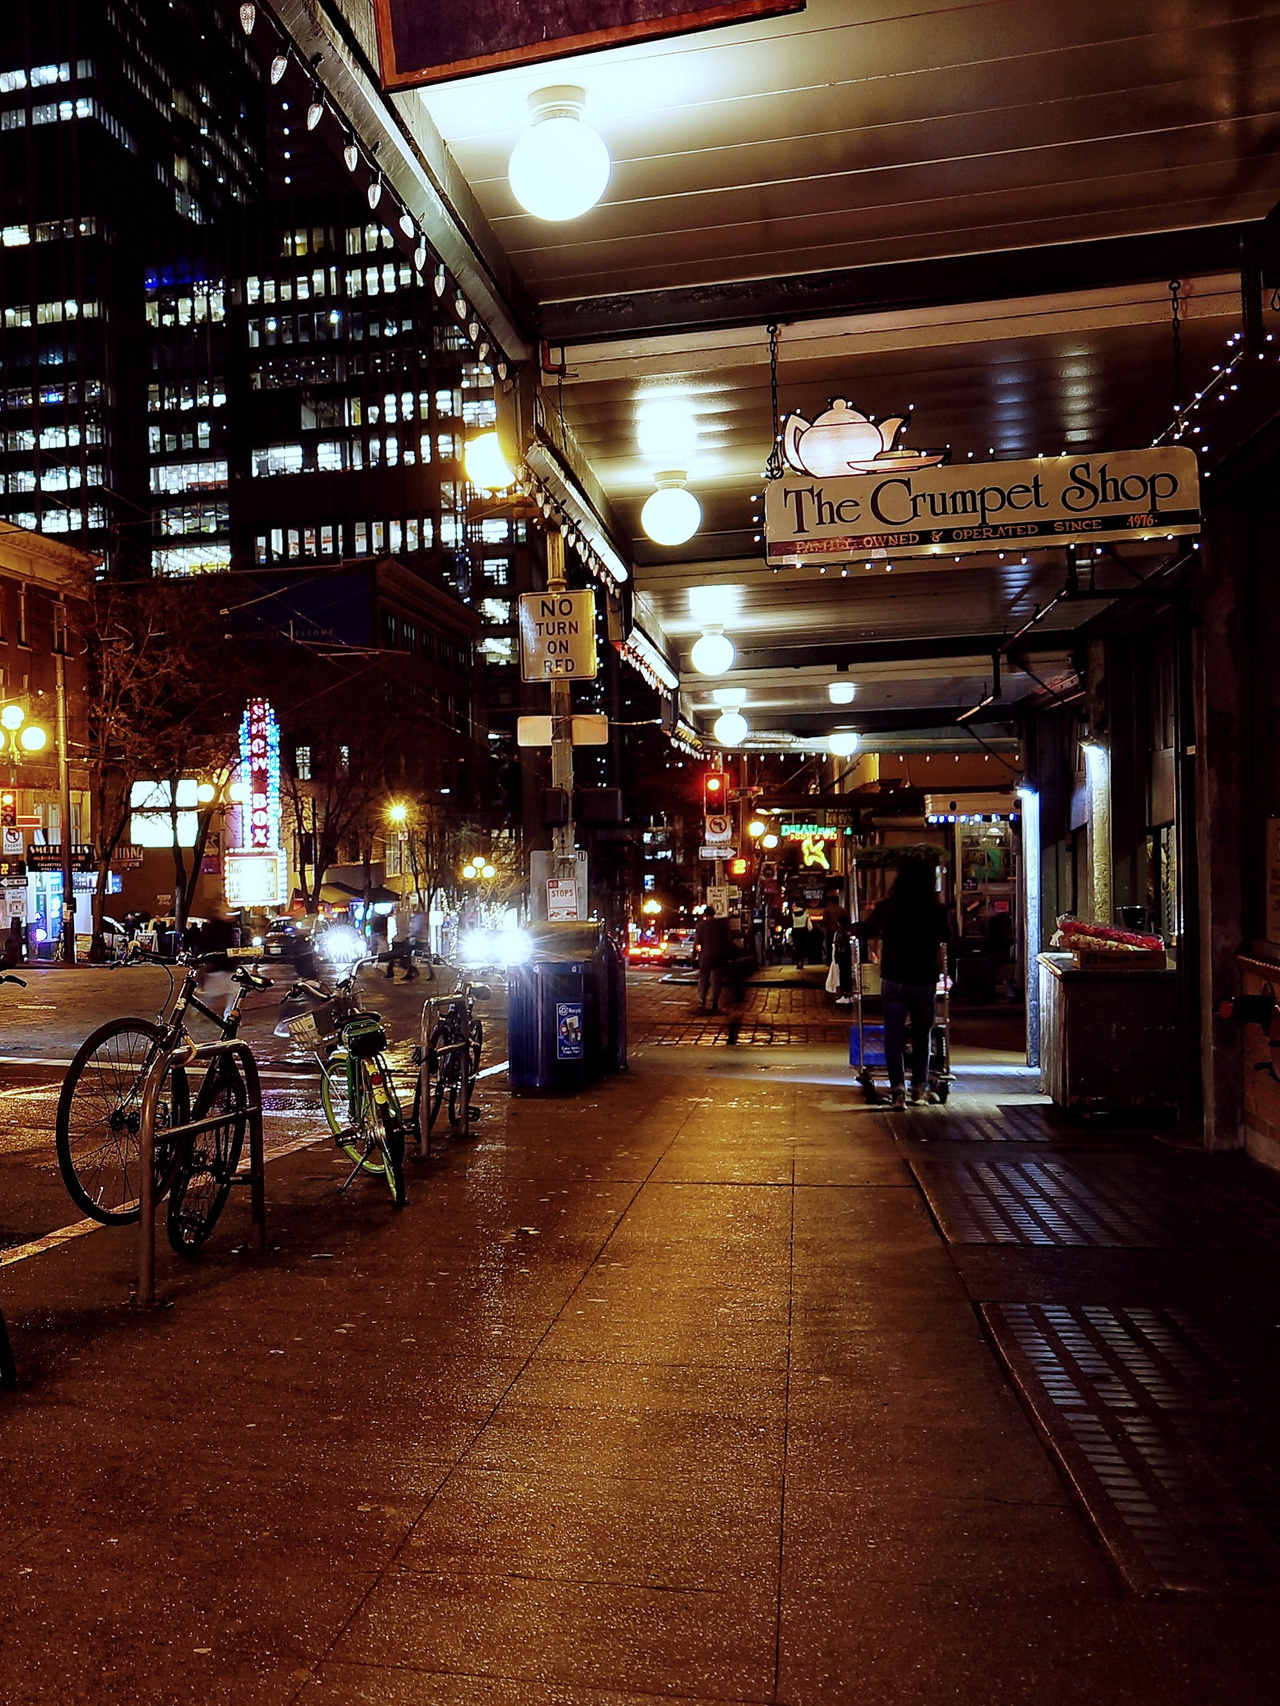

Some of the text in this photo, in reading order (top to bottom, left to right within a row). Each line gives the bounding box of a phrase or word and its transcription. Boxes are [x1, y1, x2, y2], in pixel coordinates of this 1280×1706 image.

[783, 461, 1179, 535] The Crumpet Shop
[795, 536, 853, 554] FAMILY
[863, 533, 920, 549] OWNED
[930, 530, 944, 543] &
[952, 525, 1039, 541] OPERATED
[1053, 519, 1103, 532] SINCE
[541, 598, 573, 618] NO
[535, 620, 579, 637] TURN
[547, 640, 569, 654] ON
[543, 658, 575, 673] RED
[71, 845, 90, 854] LUS
[551, 889, 574, 898] STOPS
